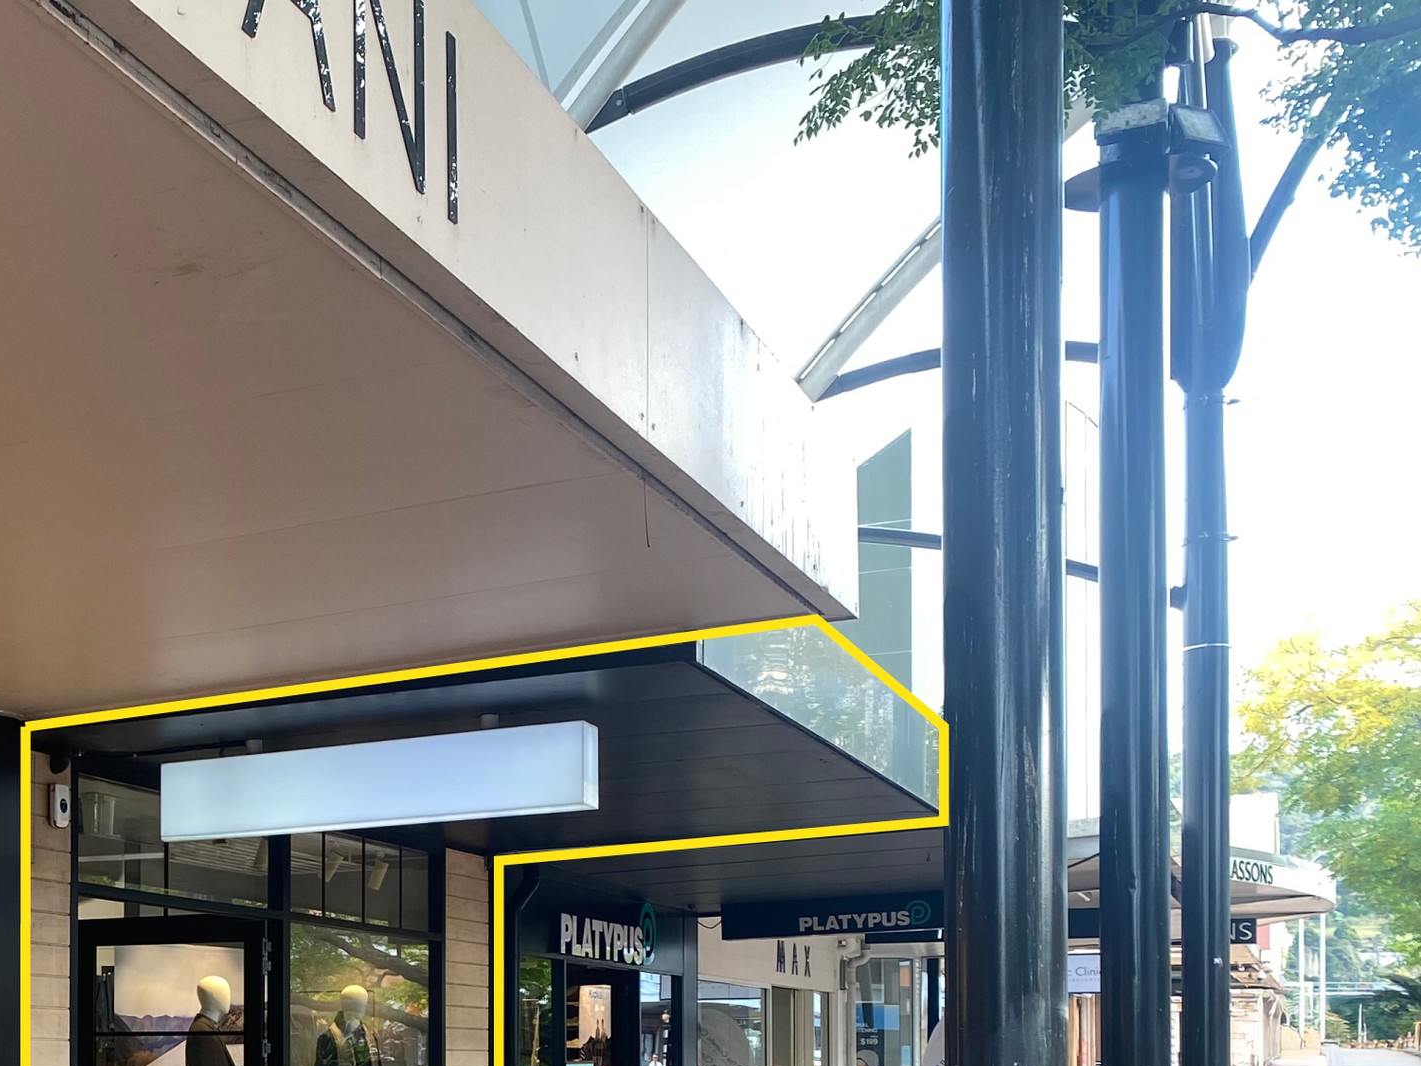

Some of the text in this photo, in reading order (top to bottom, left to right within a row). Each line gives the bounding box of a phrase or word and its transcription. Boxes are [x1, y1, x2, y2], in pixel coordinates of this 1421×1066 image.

[799, 910, 911, 932] PLATYPUS
[560, 912, 644, 965] PLATYPUS
[776, 940, 811, 978] MAX
[1076, 966, 1101, 977] Clini
